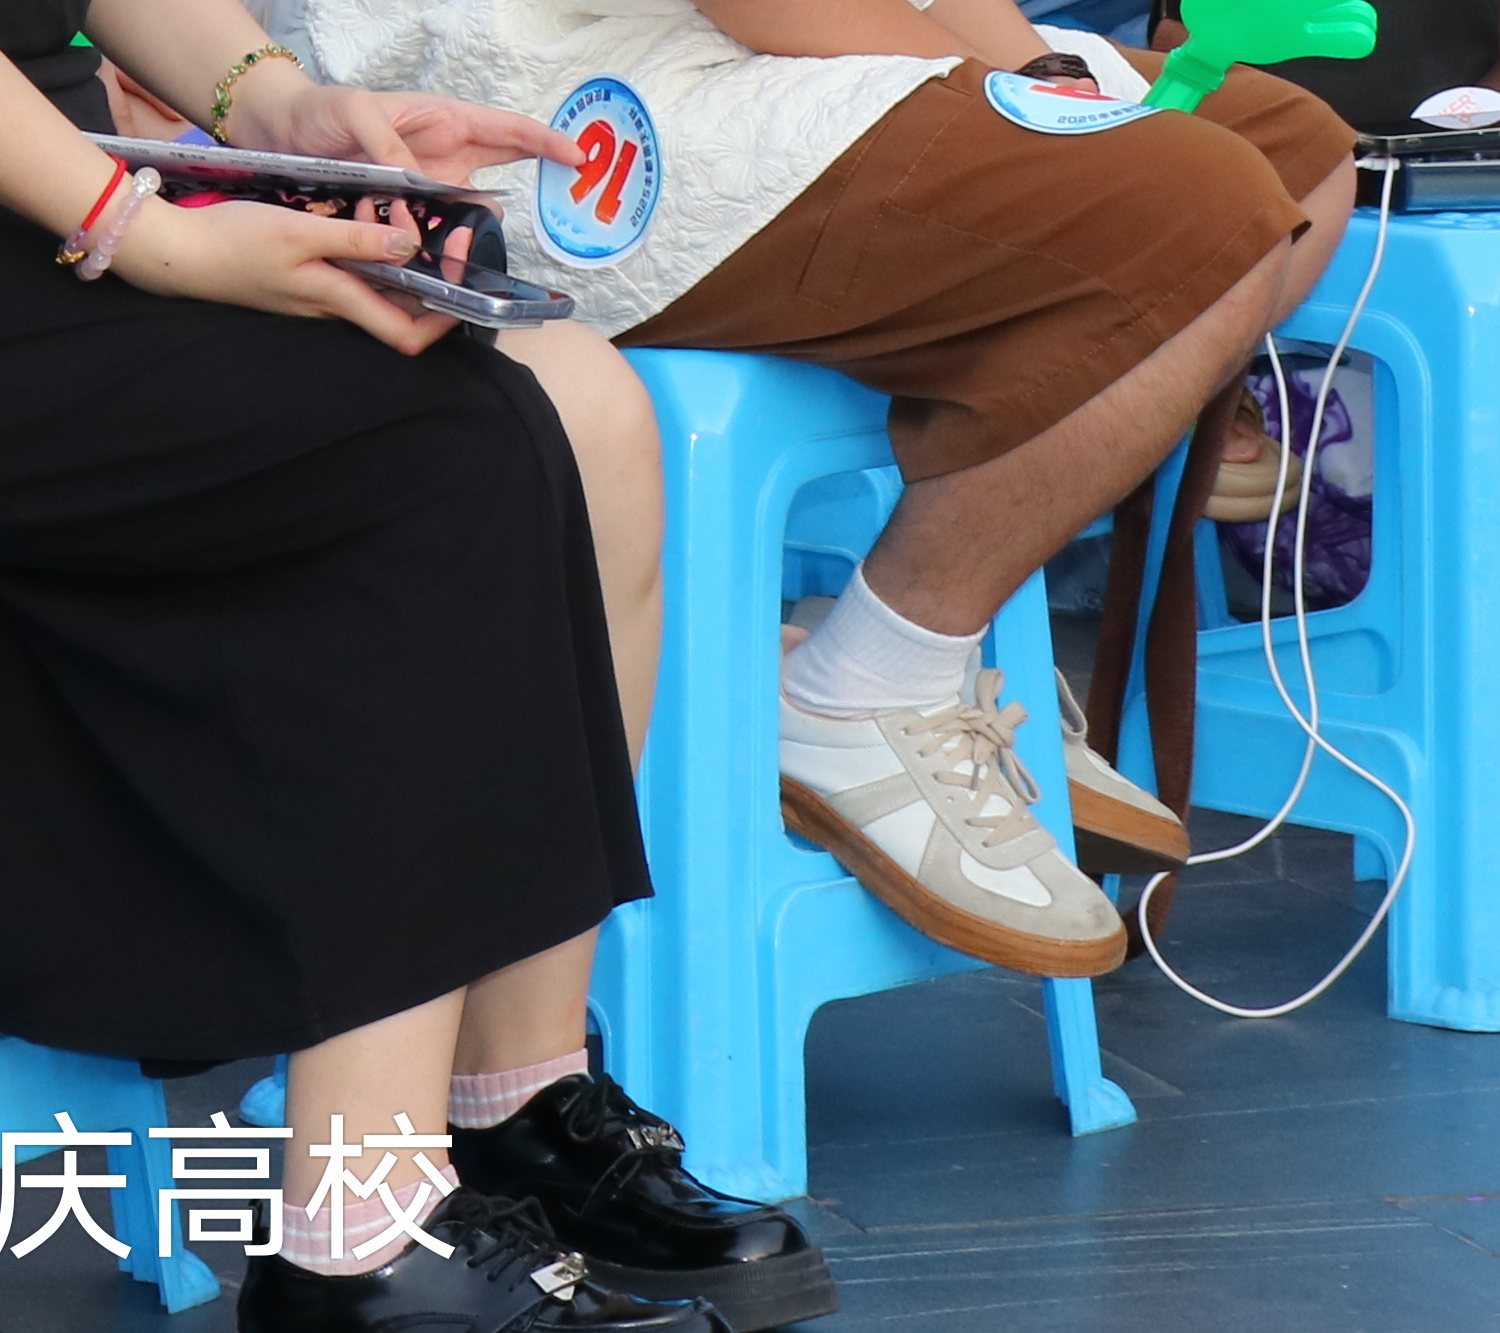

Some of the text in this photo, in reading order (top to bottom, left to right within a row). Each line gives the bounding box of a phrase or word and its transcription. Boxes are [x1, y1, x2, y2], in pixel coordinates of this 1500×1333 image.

[556, 89, 611, 133] 重庆校园音乐
[569, 119, 638, 226] 16
